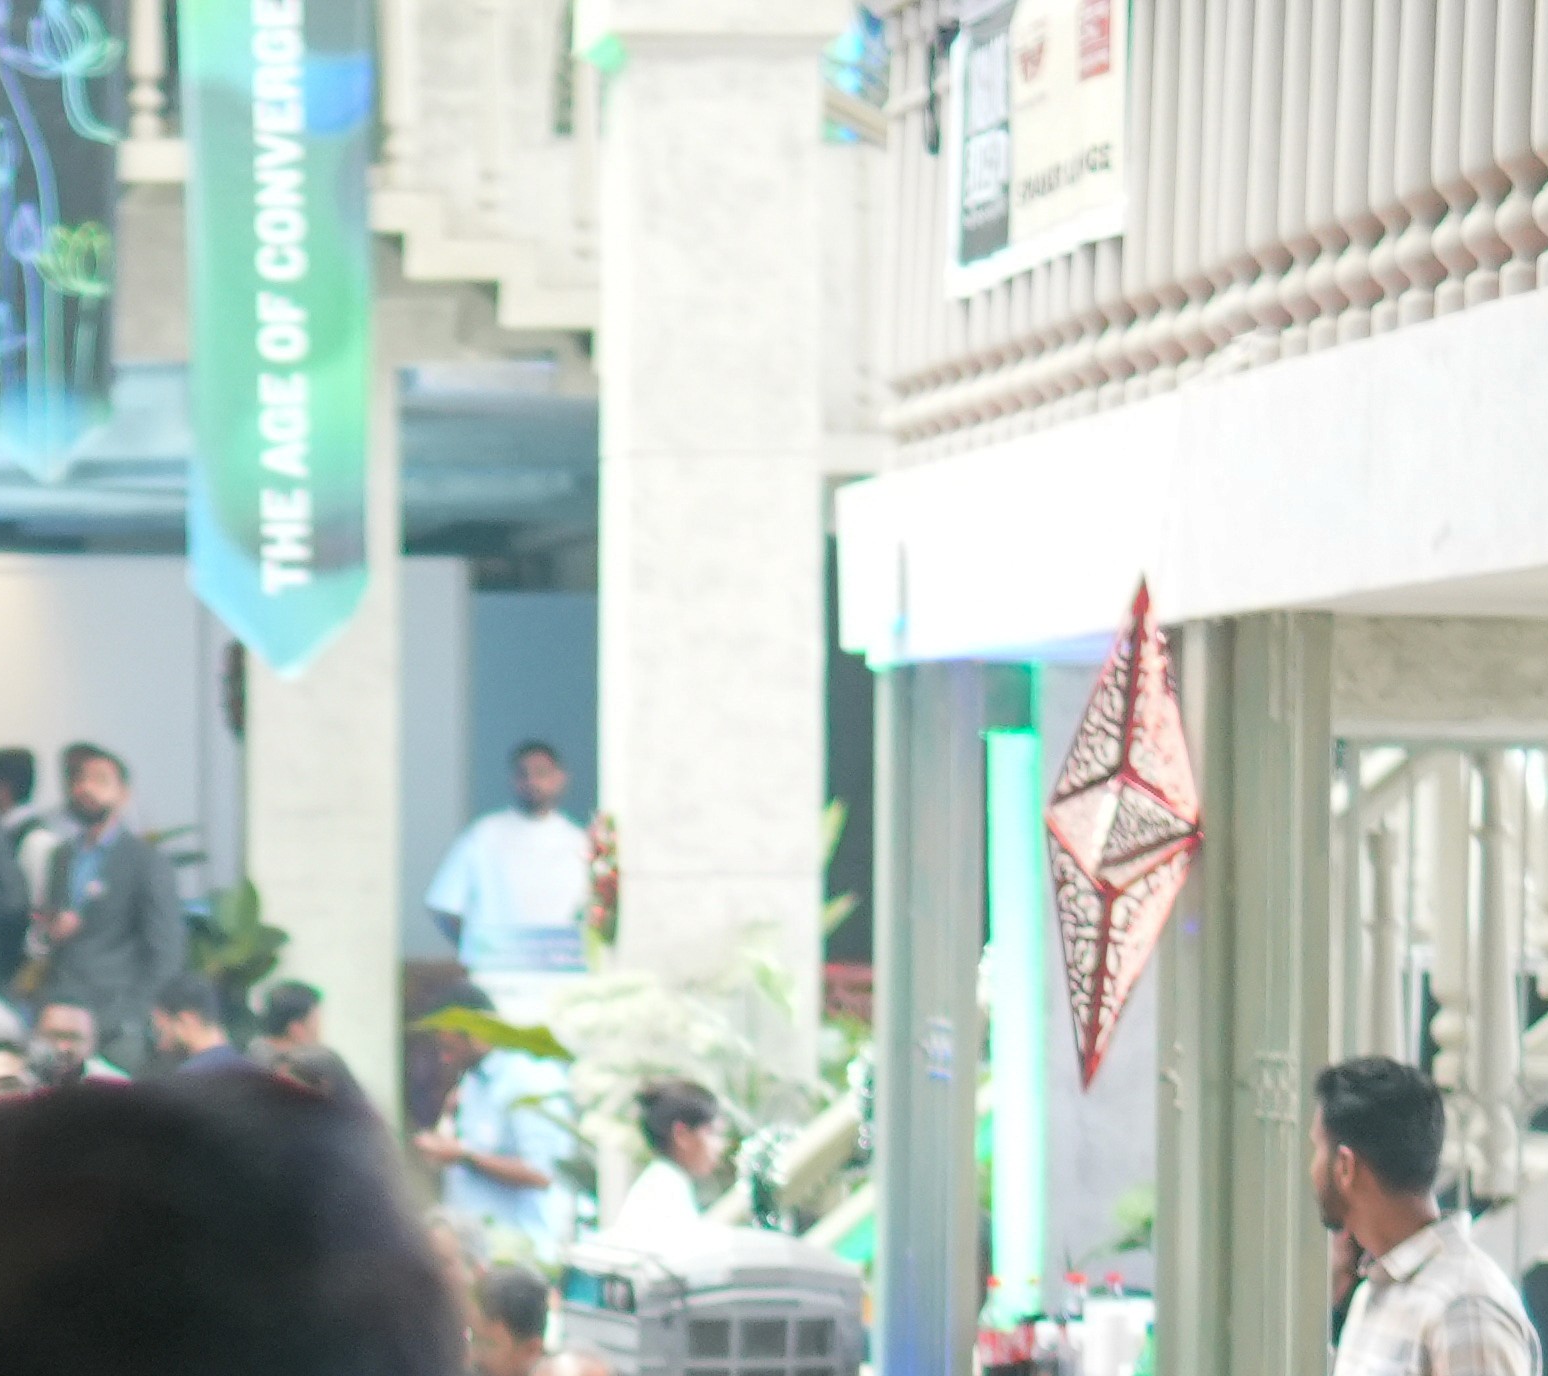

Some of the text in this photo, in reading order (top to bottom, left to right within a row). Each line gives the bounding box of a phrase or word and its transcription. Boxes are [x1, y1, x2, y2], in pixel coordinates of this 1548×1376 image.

[255, 290, 311, 364] OF
[257, 372, 313, 480] AGE
[258, 487, 314, 596] THE
